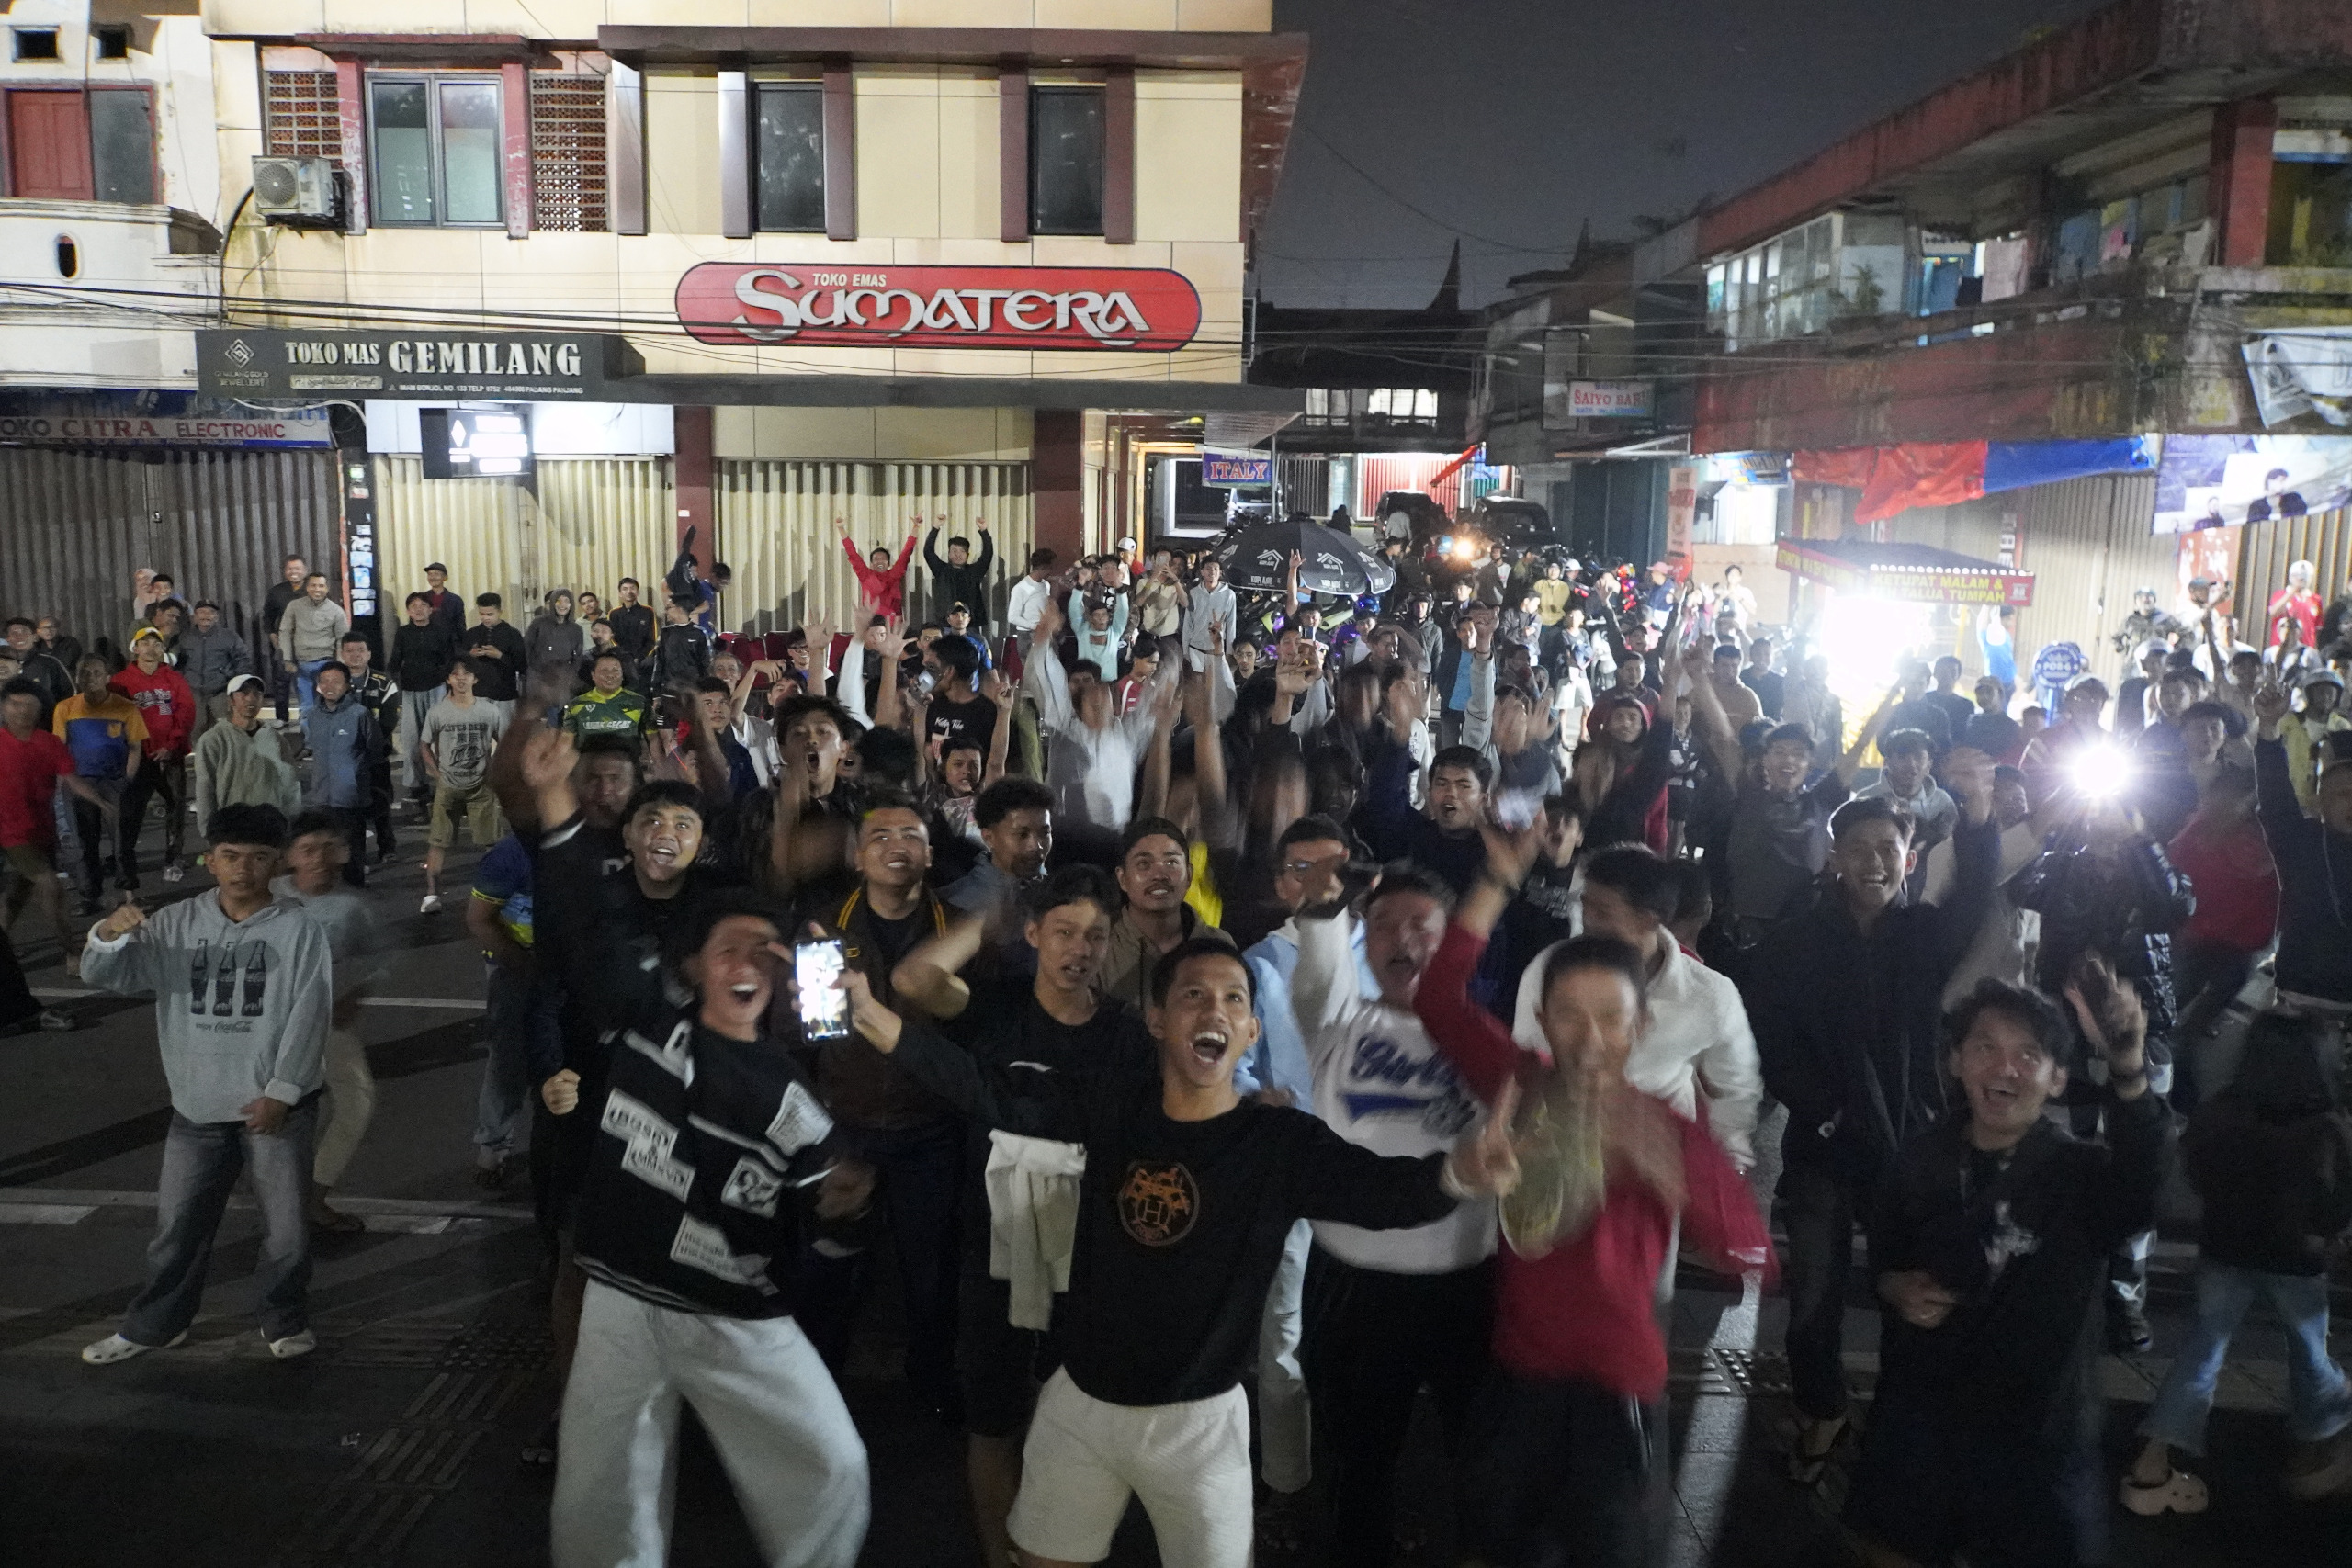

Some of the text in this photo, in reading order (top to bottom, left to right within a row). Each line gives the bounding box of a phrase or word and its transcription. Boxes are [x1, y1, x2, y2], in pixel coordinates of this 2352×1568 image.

[812, 273, 887, 288] TOKO EMAS
[285, 340, 582, 376] TOKO MAS GEMILANG
[1574, 389, 1611, 405] SAIYO
[61, 418, 159, 437] CITRA
[176, 423, 286, 438] ELECTRONIC
[1210, 461, 1267, 479] ITALY
[1873, 573, 2004, 591] KETUPAT MALAM &
[1950, 589, 2006, 603] TUMPAH
